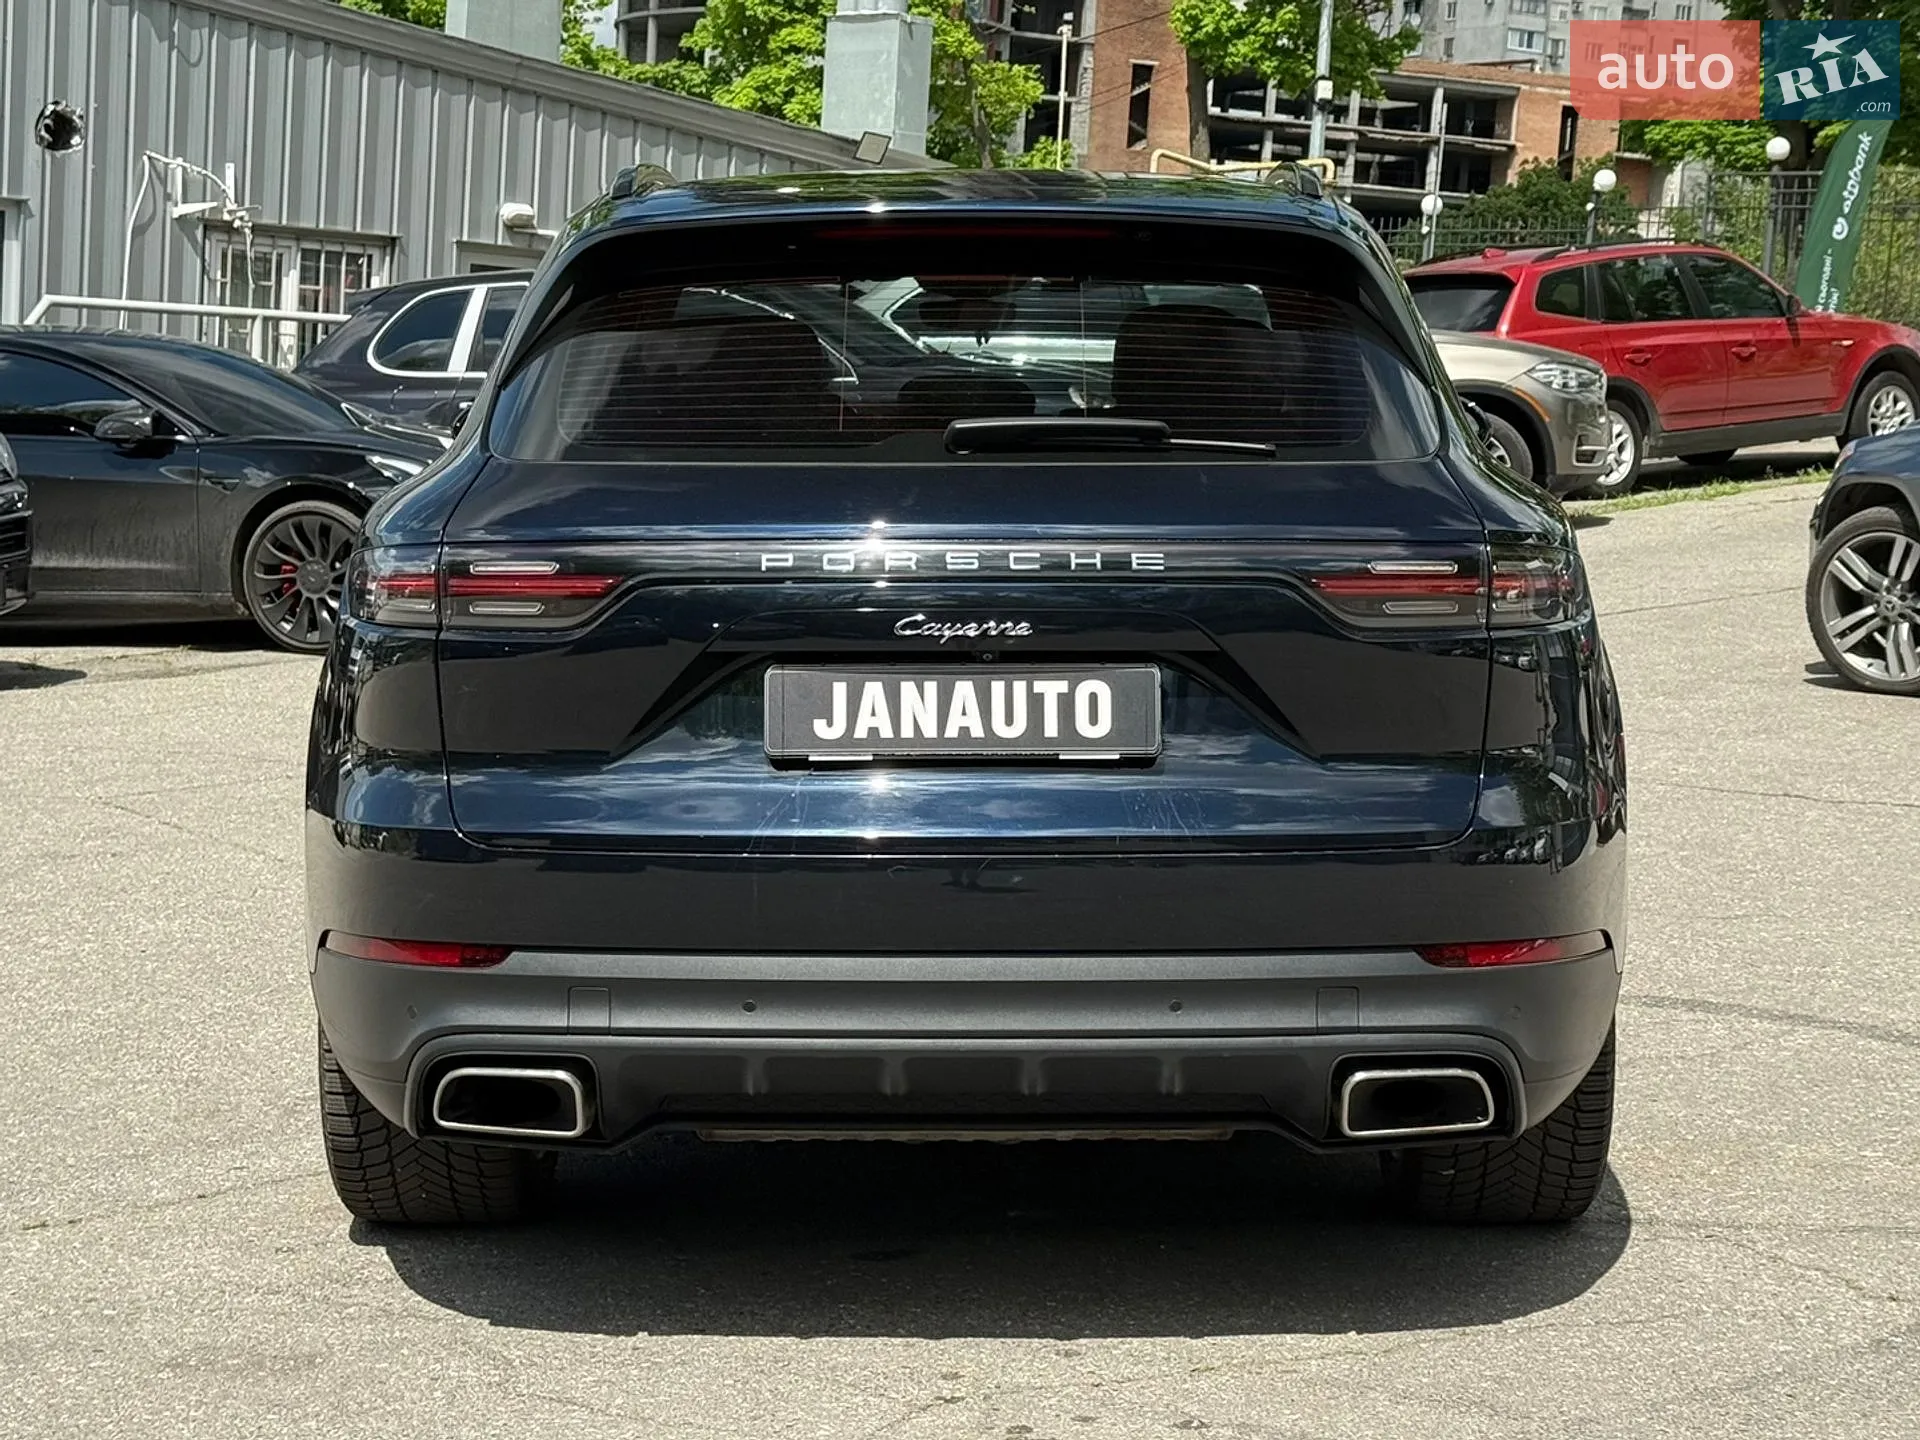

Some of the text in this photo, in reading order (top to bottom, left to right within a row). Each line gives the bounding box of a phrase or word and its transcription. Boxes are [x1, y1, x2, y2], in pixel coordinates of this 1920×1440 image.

[1842, 131, 1873, 214] otpbank
[761, 551, 1166, 571] PORSCHE
[894, 613, 1033, 644] Cayenne
[813, 679, 1113, 740] JANAUTO
